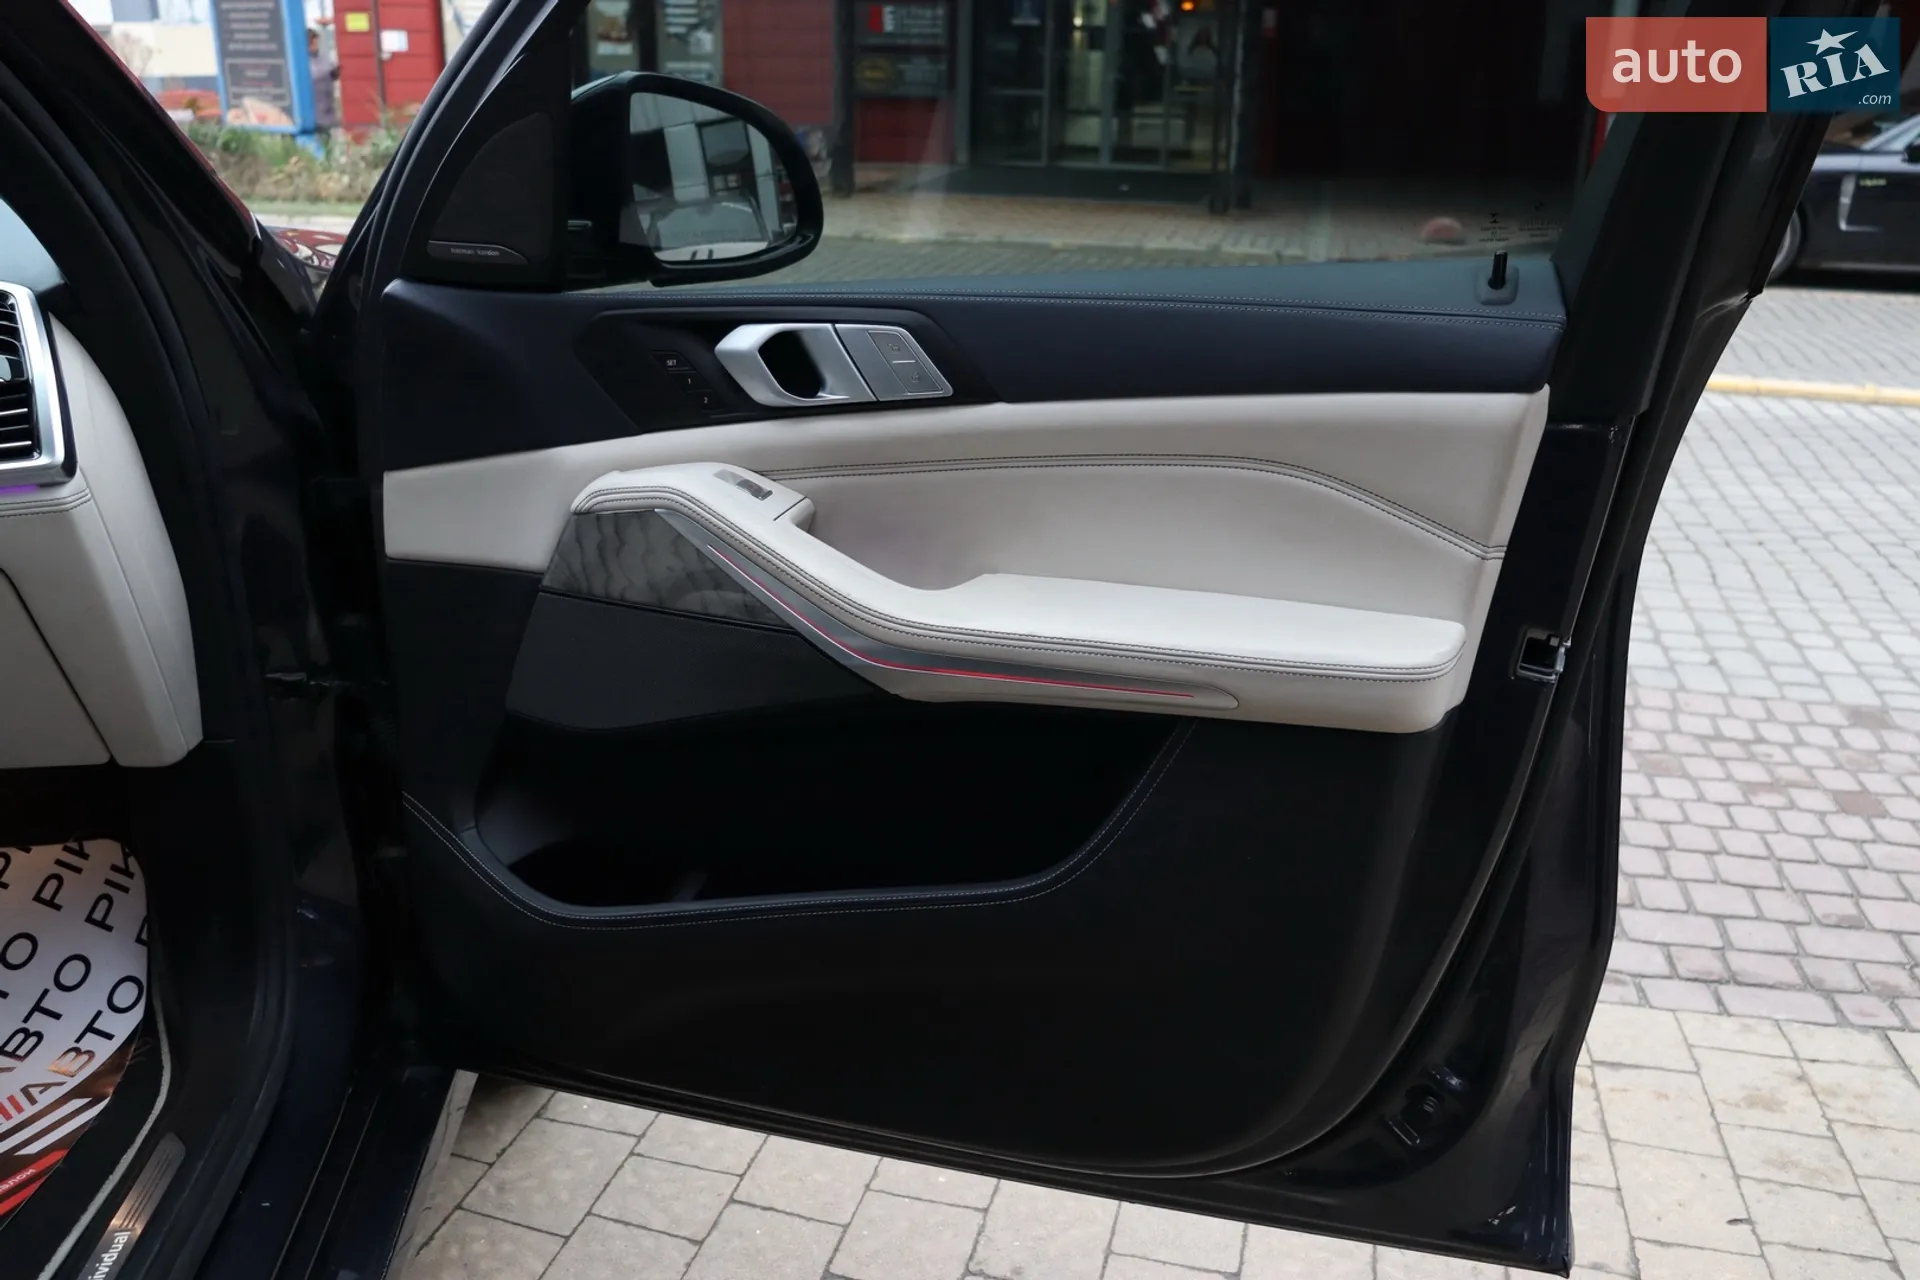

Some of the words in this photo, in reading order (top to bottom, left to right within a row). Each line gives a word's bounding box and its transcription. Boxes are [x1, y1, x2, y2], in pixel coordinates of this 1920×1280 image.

[704, 396, 708, 404] 2
[0, 954, 92, 1074] ВТО
[20, 974, 145, 1106] АВТО
